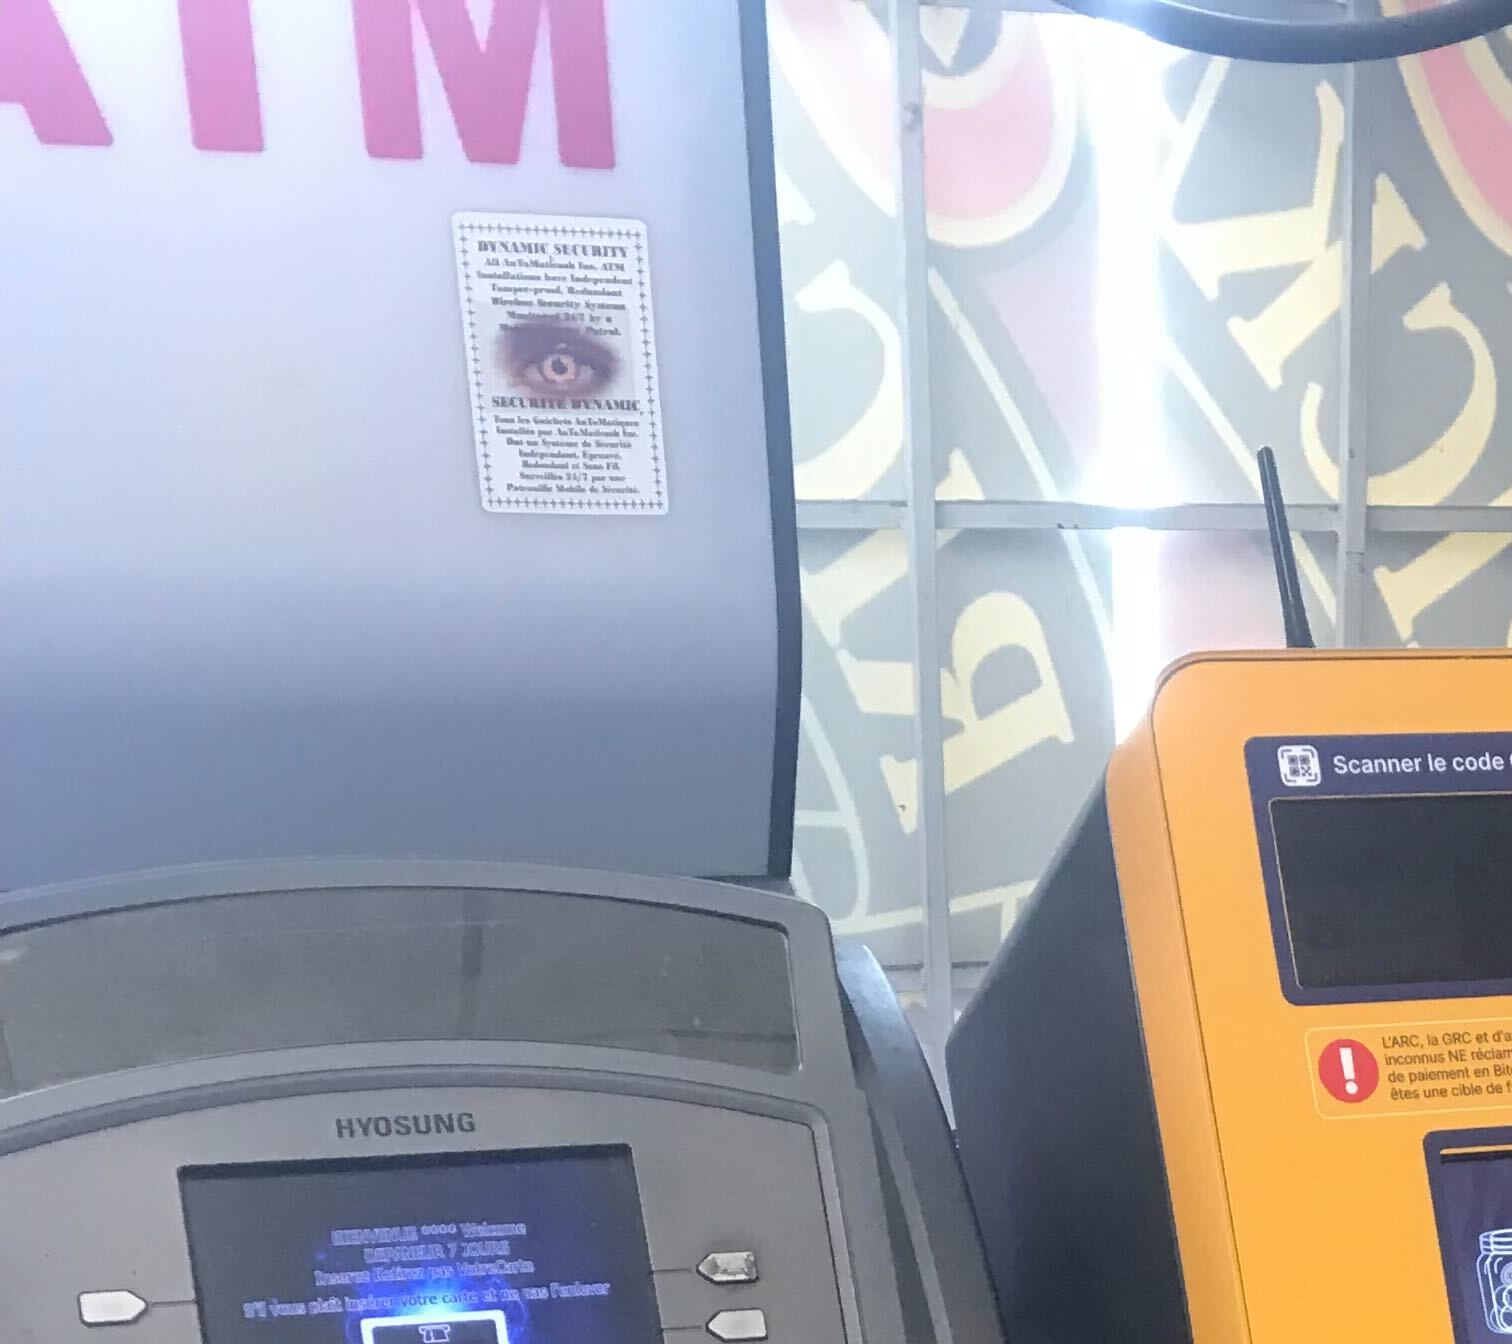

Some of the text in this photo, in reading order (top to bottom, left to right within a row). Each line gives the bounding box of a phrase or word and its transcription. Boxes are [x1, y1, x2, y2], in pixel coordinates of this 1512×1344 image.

[478, 240, 628, 258] DYNAMIC SECURITY
[1333, 753, 1421, 775] Scanner
[1427, 753, 1447, 772] le
[1451, 751, 1503, 772] code
[1382, 1034, 1424, 1049] L'ARC,
[1428, 1033, 1438, 1046] la
[1442, 1031, 1472, 1046] GRC
[1475, 1031, 1491, 1044] et
[1384, 1050, 1445, 1066] inconnus
[1448, 1049, 1467, 1063] NE
[1388, 1070, 1406, 1082] de
[1408, 1066, 1469, 1085] paiement
[1474, 1068, 1490, 1079] en
[1390, 1086, 1420, 1101] êtes
[1423, 1086, 1448, 1099] une
[1451, 1082, 1483, 1097] cible
[1486, 1080, 1504, 1095] de
[335, 1112, 476, 1139] HYOSUNG
